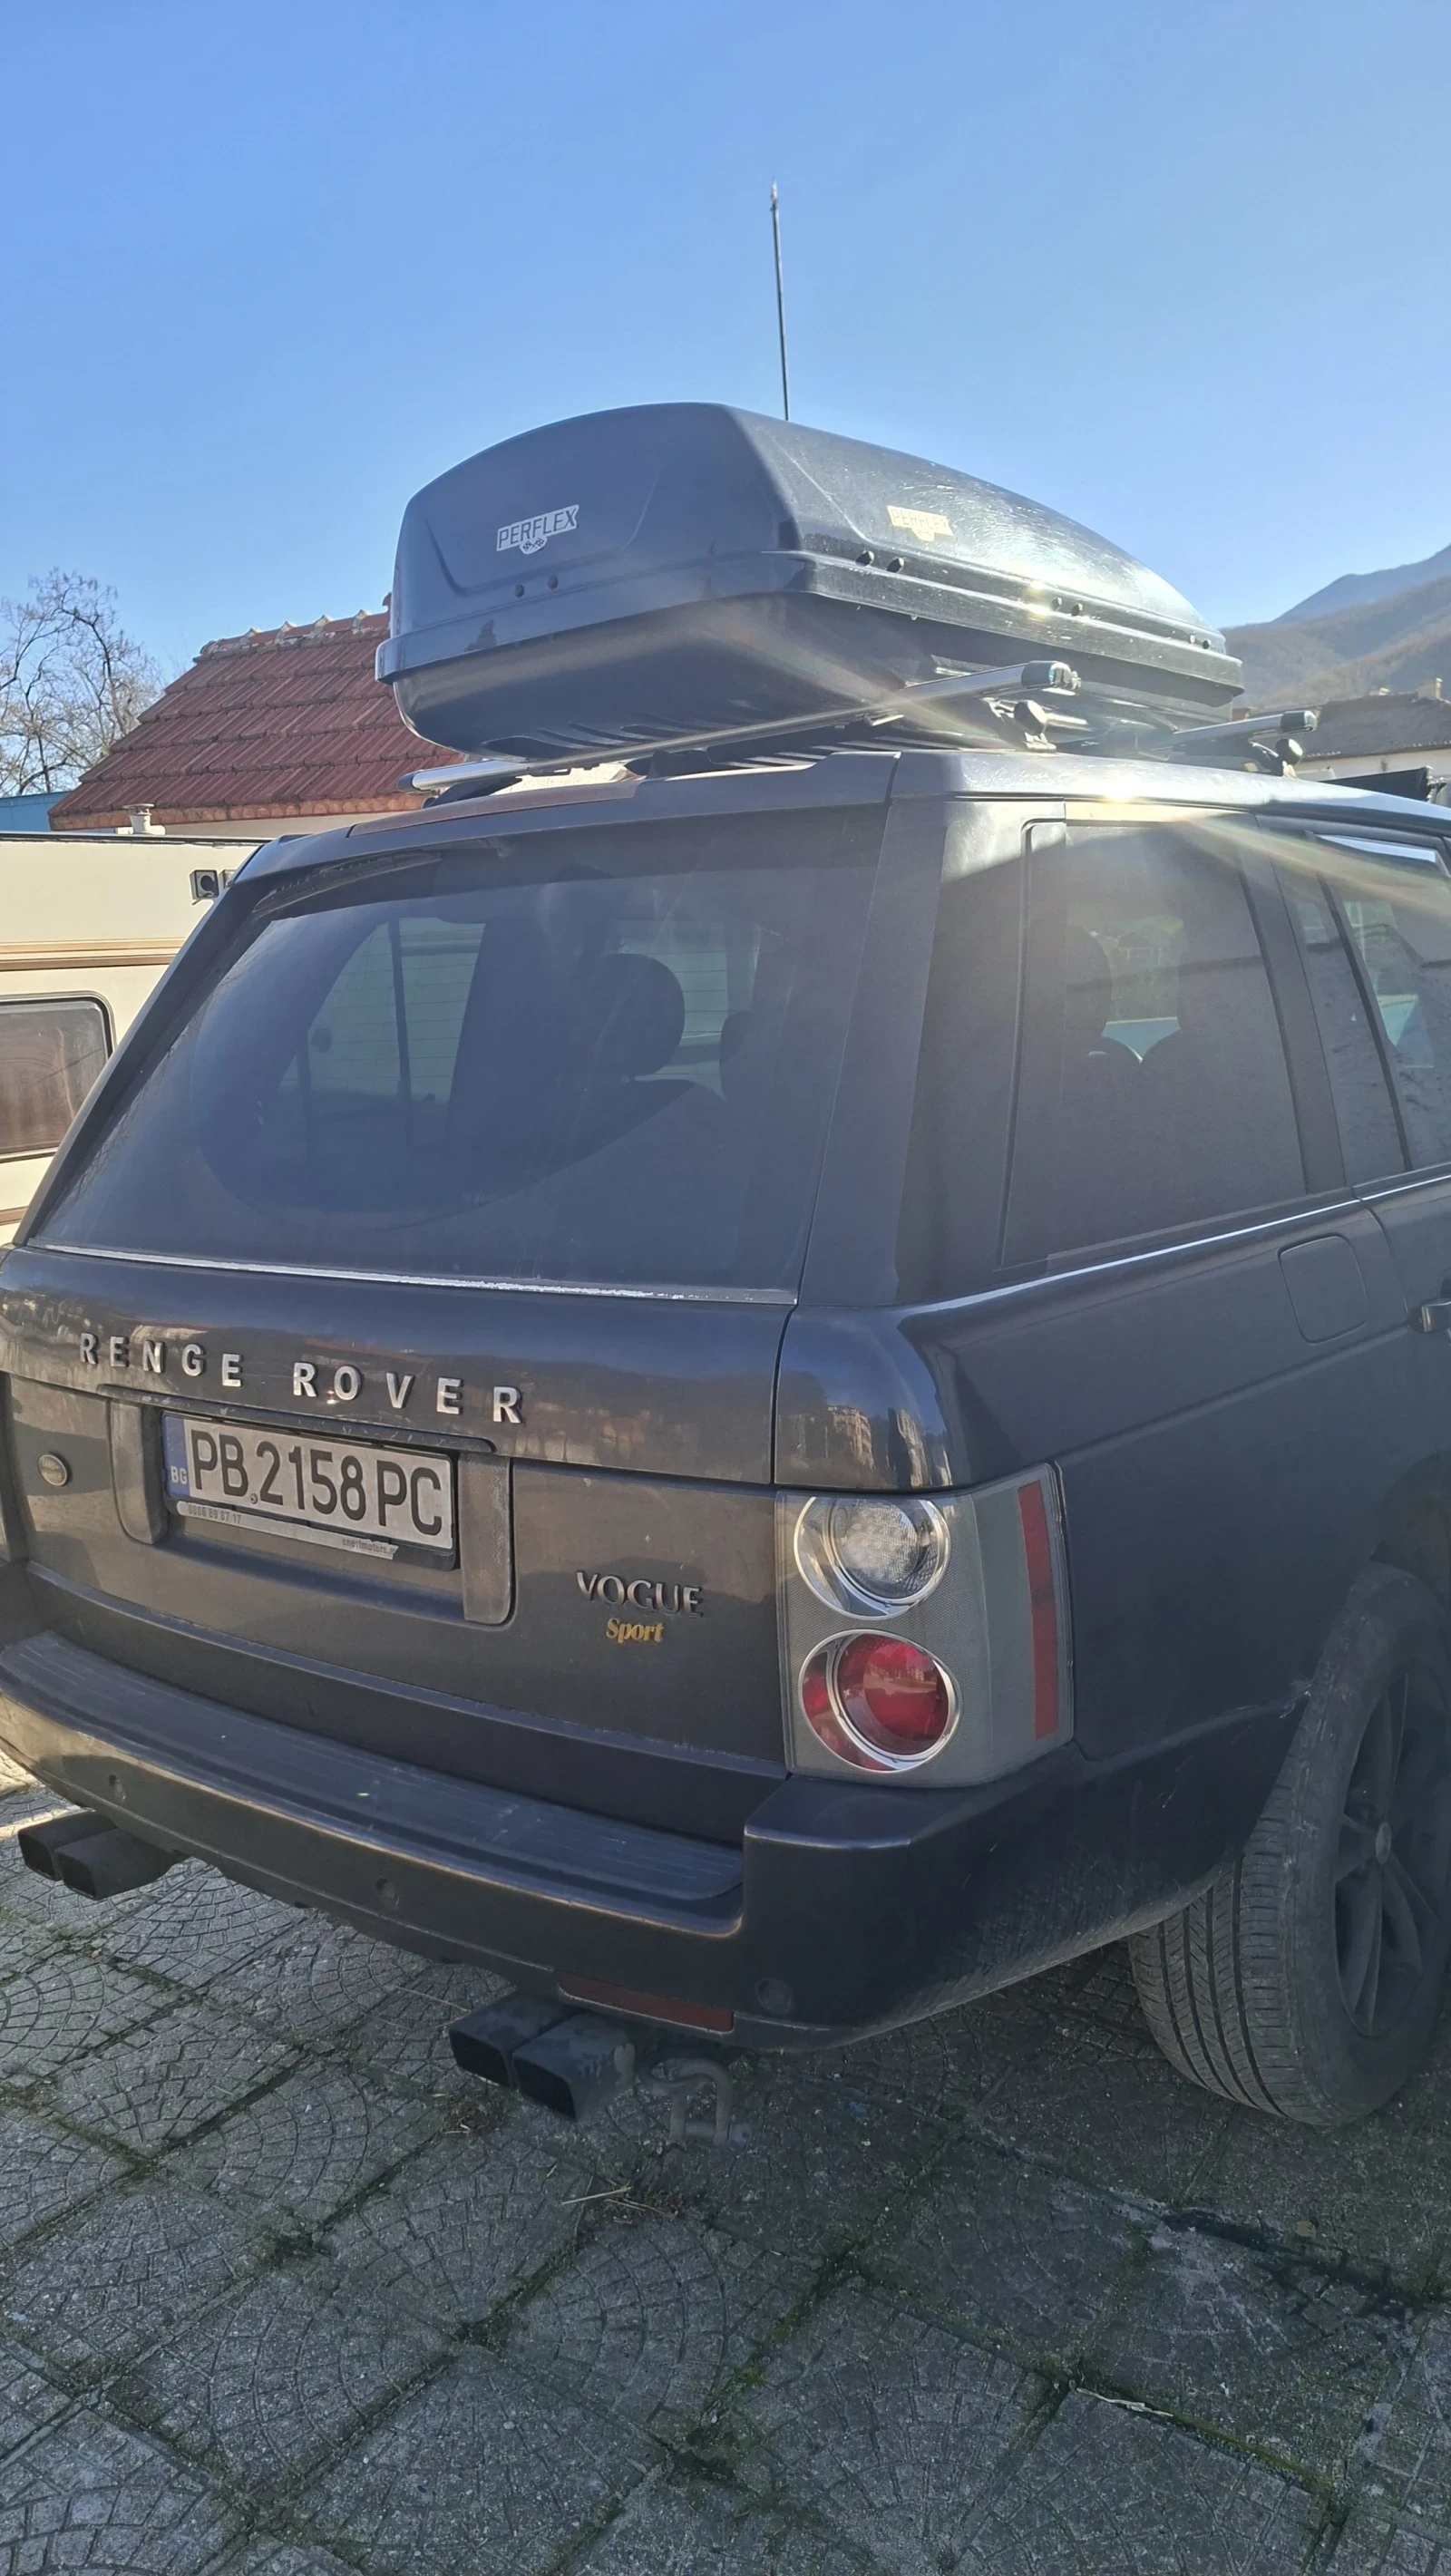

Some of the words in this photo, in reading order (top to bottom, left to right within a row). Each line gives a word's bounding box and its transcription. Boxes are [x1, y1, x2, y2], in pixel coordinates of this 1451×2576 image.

[498, 507, 578, 549] PERFLEX
[79, 1332, 243, 1388] RENGE
[292, 1361, 525, 1424] ROVER
[170, 1465, 188, 1485] BG
[232, 1513, 242, 1525] 17
[576, 1570, 704, 1617] VOGUE
[605, 1617, 665, 1644] Sport
